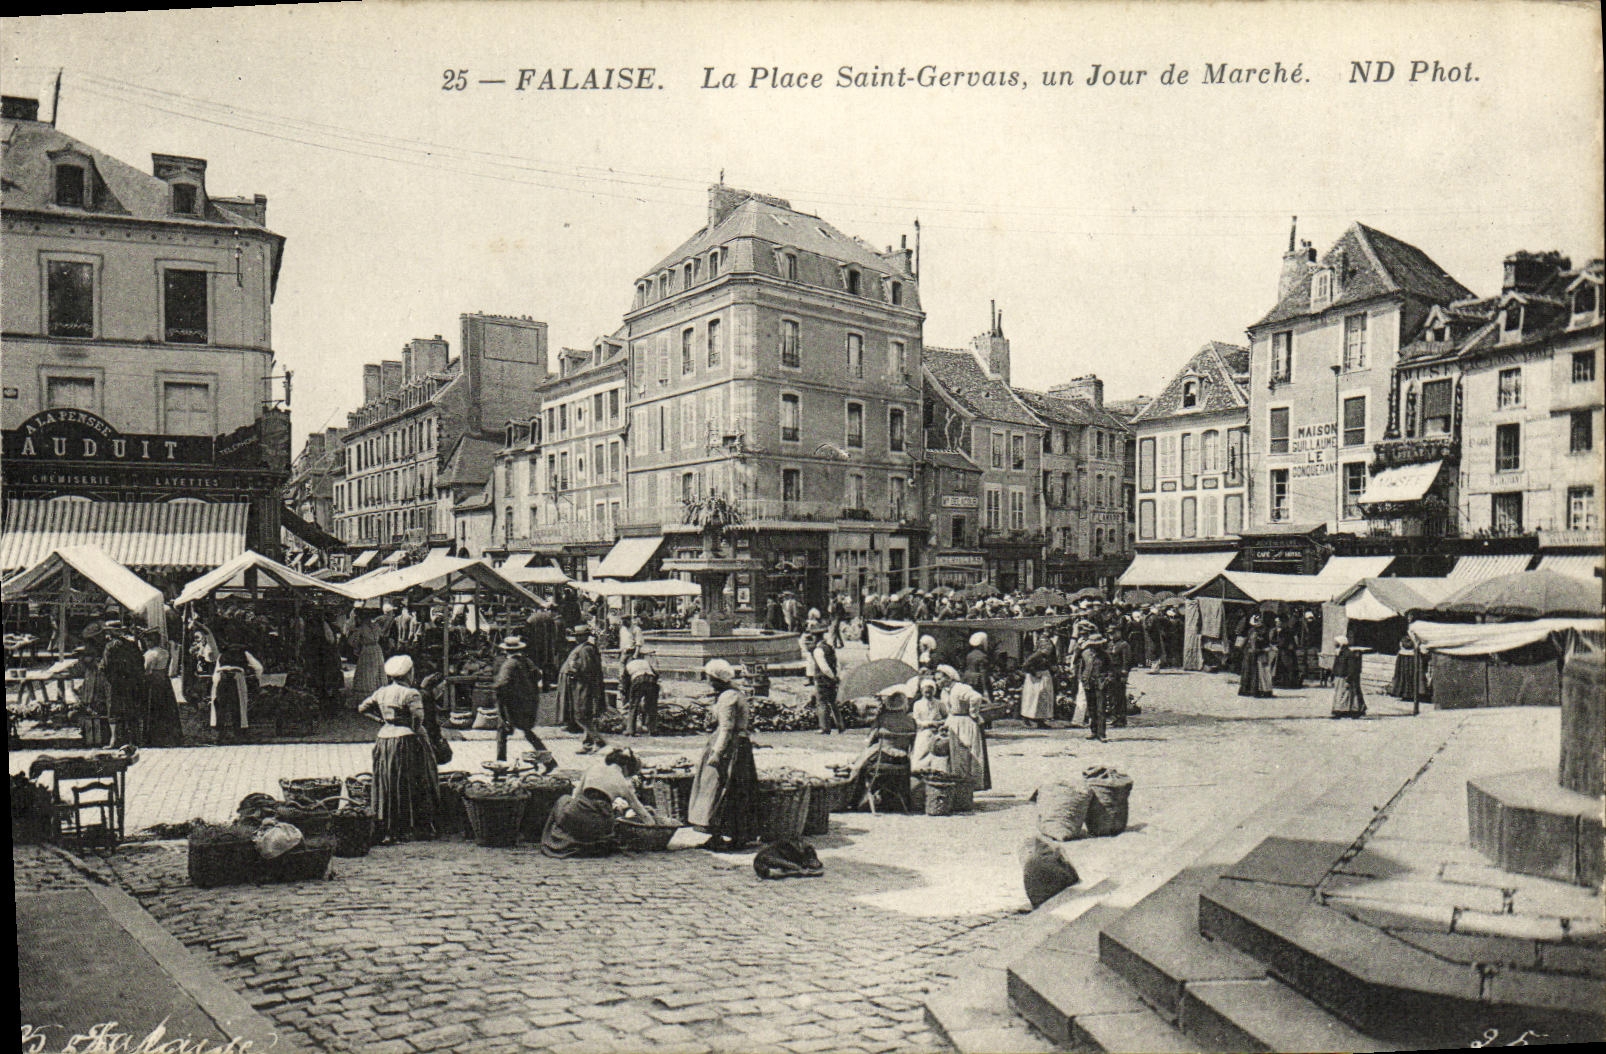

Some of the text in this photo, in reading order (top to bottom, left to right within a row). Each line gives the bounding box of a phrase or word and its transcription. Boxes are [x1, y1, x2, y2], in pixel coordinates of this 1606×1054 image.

[35, 412, 57, 427] LA
[1297, 422, 1337, 438] MAISON
[0, 431, 177, 459] AUDUIT
[1292, 436, 1337, 452] GUILLAUME
[1307, 450, 1324, 463] LE
